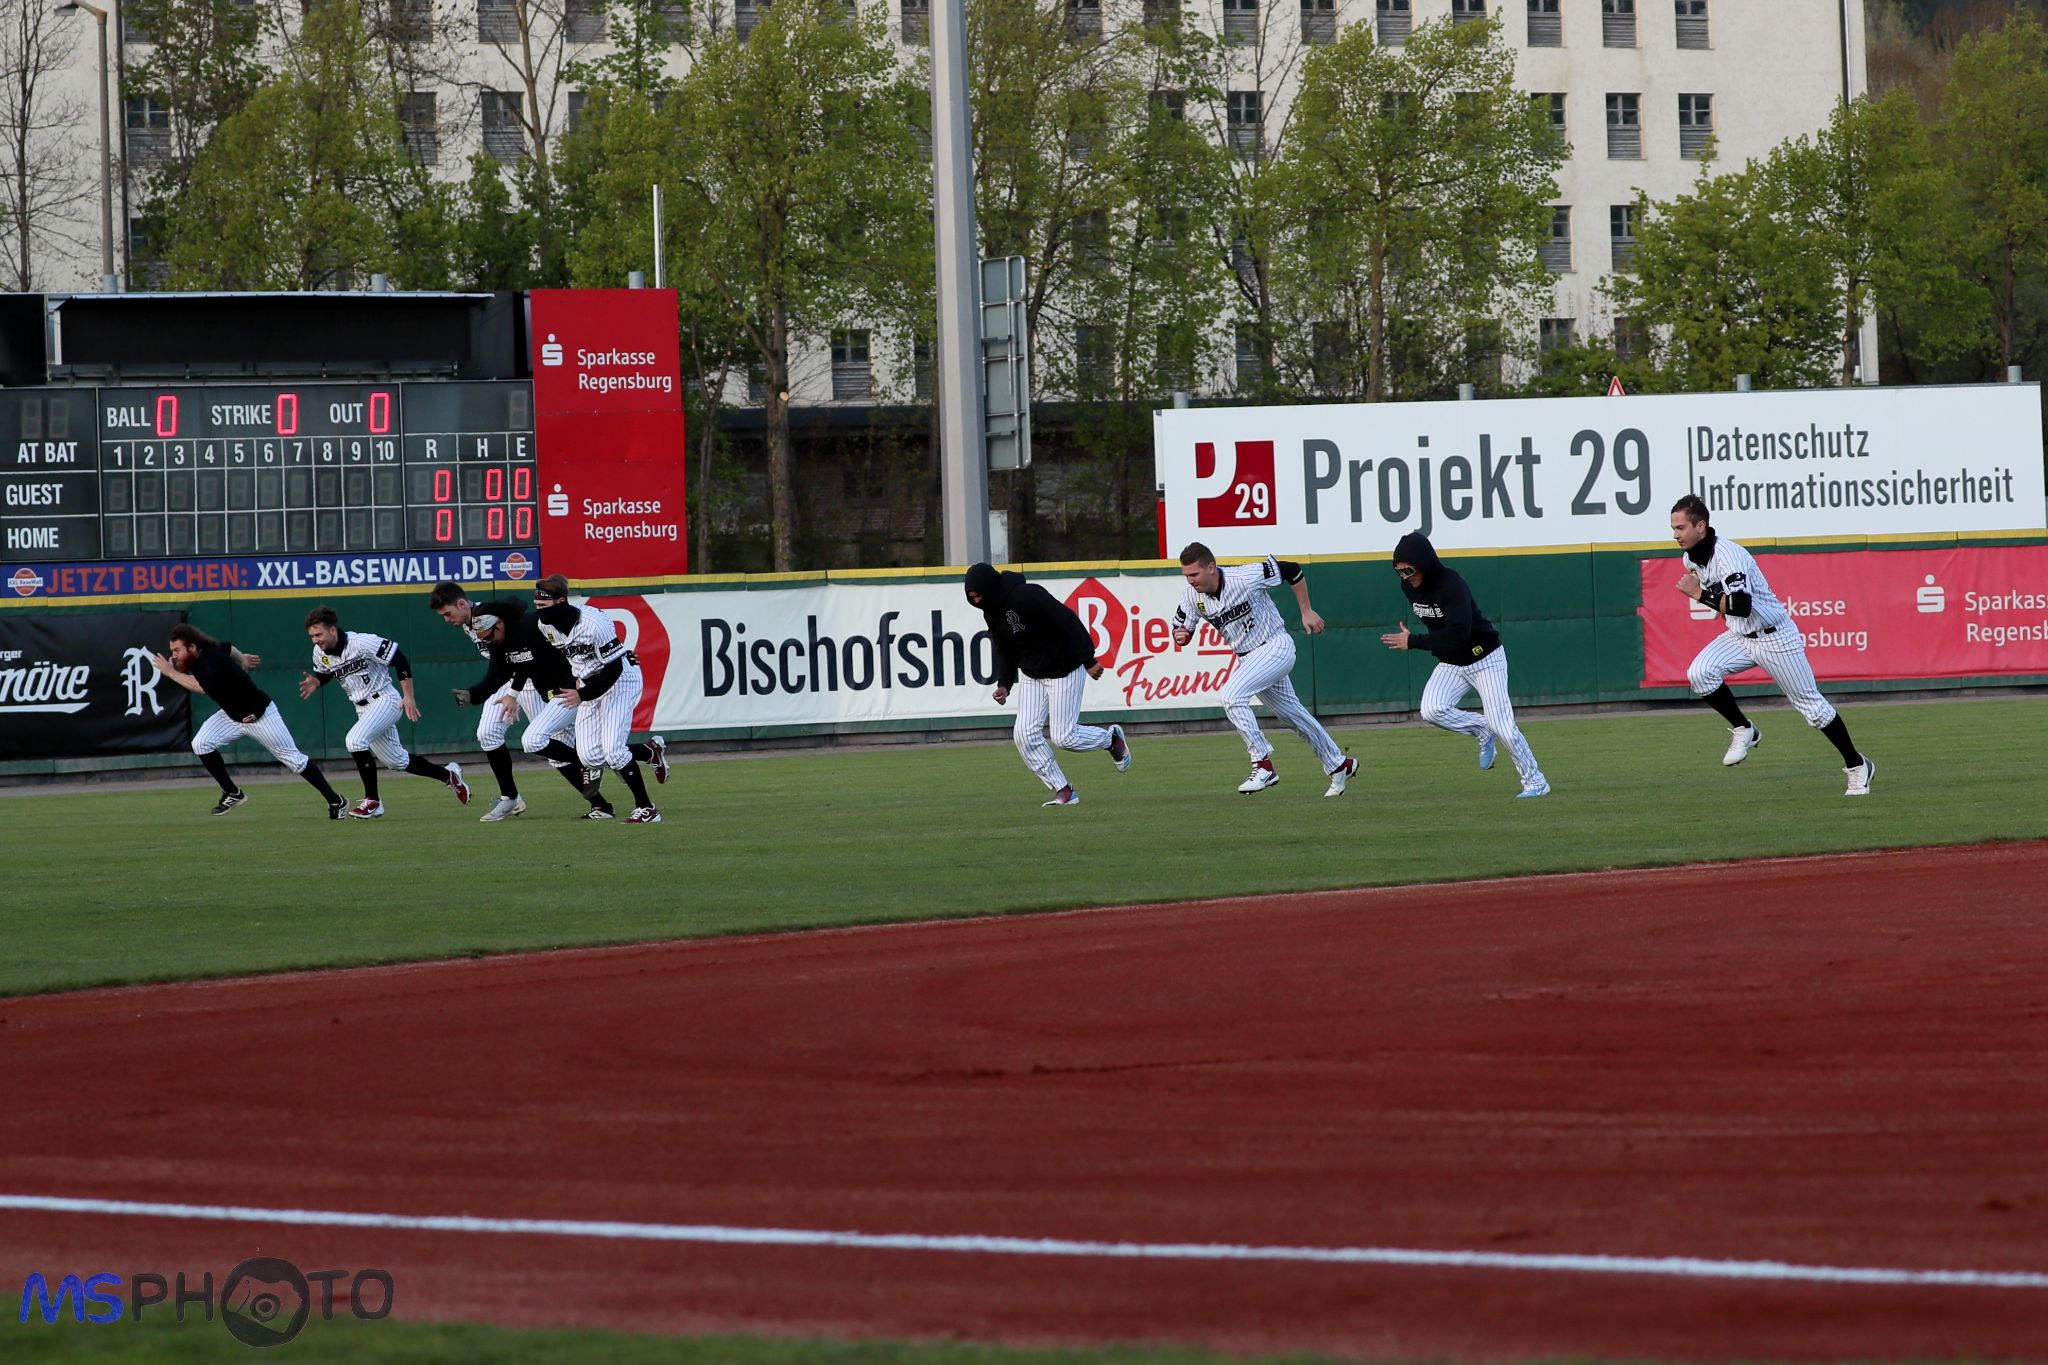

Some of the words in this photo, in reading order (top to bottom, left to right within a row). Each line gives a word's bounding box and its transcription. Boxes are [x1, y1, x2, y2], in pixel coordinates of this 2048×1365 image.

[577, 348, 656, 369] Sparkasse
[578, 372, 673, 394] Regensburg
[106, 405, 151, 428] BALL
[155, 395, 178, 437] 0
[211, 403, 272, 426] STRIKE
[276, 393, 298, 435] 0
[329, 402, 364, 424] OUT
[369, 391, 391, 433] 0
[17, 442, 39, 464] AT
[44, 441, 78, 463] BAT
[113, 446, 122, 466] 1
[143, 446, 155, 465] 2
[174, 445, 185, 465] 3
[204, 444, 215, 463] 4
[234, 443, 245, 463] 5
[263, 443, 274, 462] 6
[292, 442, 303, 462] 7
[322, 441, 333, 461] 8
[351, 441, 362, 461] 9
[375, 440, 395, 460] 10
[425, 439, 438, 459] R
[477, 438, 489, 458] H
[516, 437, 527, 457] E
[1697, 422, 1870, 462] Datenschutz
[5, 483, 64, 506] GUEST
[434, 469, 451, 502] 0
[485, 468, 503, 501] 0
[513, 467, 531, 500] 0
[1302, 434, 1544, 537] Projekt
[1569, 427, 1652, 517] 29
[1700, 467, 2015, 513] Informationssicherheit
[583, 497, 661, 519] Sparkasse
[1234, 483, 1270, 520] 29
[7, 527, 60, 549] HOME
[435, 508, 452, 541] 0
[486, 507, 504, 540] 0
[515, 506, 532, 539] 0
[584, 521, 678, 544] Regensburg
[45, 566, 125, 594] JETZT
[132, 563, 249, 591] BUCHEN:
[256, 555, 494, 588] XXL-BASEWALL.DE
[1964, 589, 2048, 616] Sparkas
[1242, 617, 1255, 633] 12
[701, 610, 1018, 697] Bischofsho
